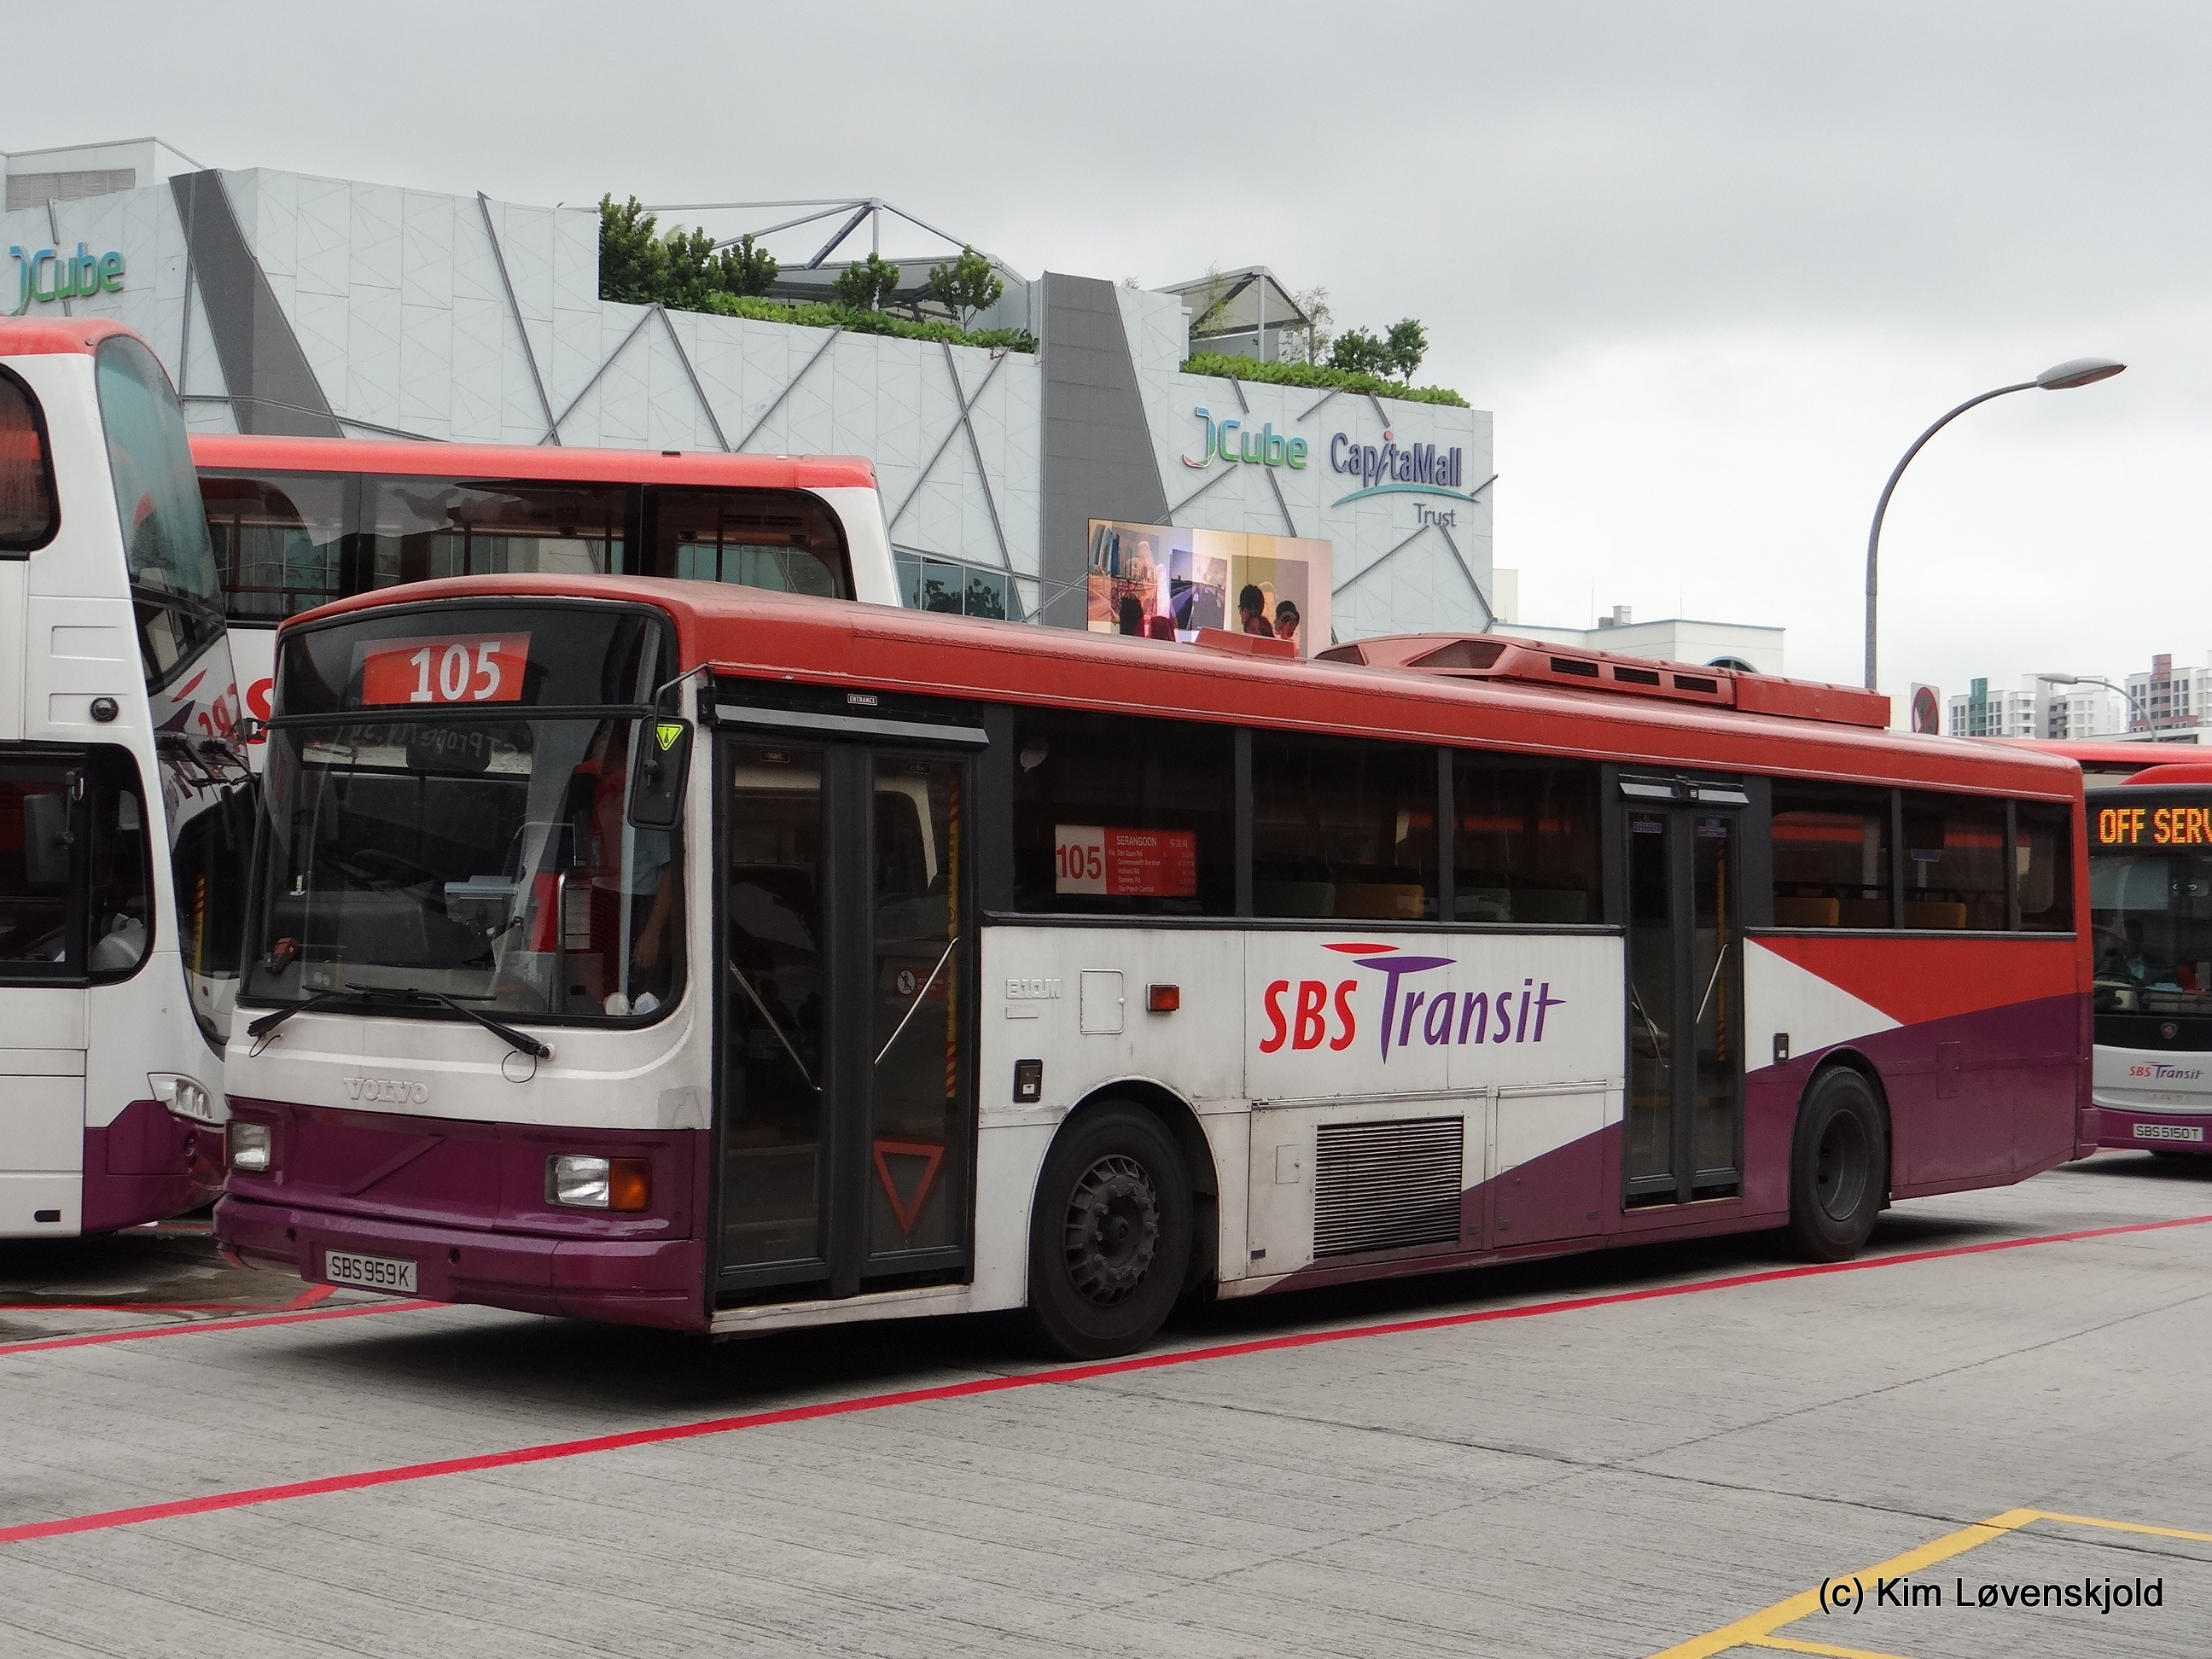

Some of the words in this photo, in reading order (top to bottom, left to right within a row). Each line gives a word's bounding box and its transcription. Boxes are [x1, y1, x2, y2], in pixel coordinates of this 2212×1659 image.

[1331, 430, 1462, 487] CapitaMall
[1413, 503, 1457, 527] Trust
[410, 640, 502, 703] 105
[849, 696, 876, 704] ENTRANCE
[1116, 835, 1157, 847] SERANGOON
[2099, 808, 2145, 843] OFF
[1057, 844, 1102, 880] 105
[1259, 979, 1358, 1054] SBS
[1352, 956, 1567, 1065] Transit
[2128, 1066, 2151, 1078] SBS
[2151, 1064, 2204, 1080] Transit
[342, 1077, 429, 1104] VOLVO
